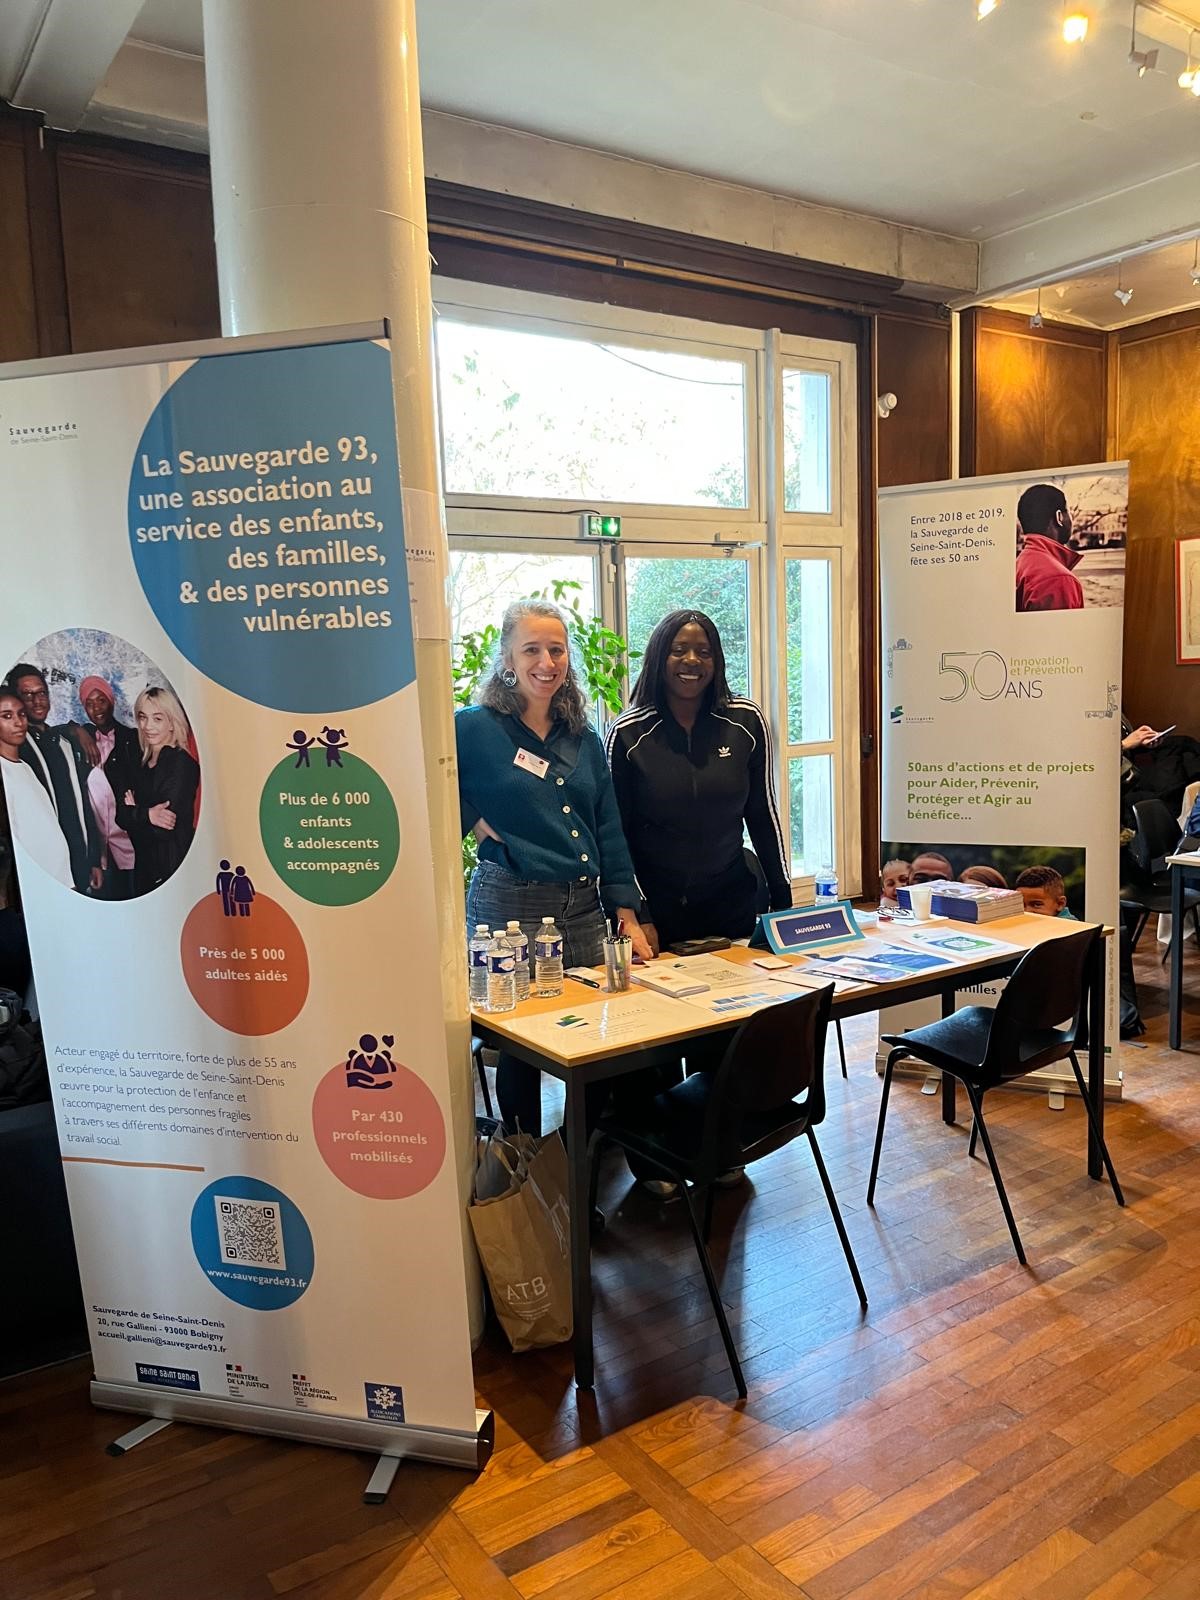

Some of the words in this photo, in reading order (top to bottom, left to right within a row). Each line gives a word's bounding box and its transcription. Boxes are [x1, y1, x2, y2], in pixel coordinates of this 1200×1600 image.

[9, 422, 77, 435] Sauvegarde
[142, 454, 173, 477] La
[178, 440, 330, 475] Sauvegarde
[337, 435, 378, 464] 93,
[139, 492, 184, 510] une
[191, 476, 332, 507] association
[340, 477, 372, 496] au
[136, 517, 222, 543] service
[229, 514, 271, 537] des
[279, 508, 384, 534] enfants,
[911, 516, 936, 525] Entre
[939, 512, 962, 522] 2018
[965, 512, 975, 520] et
[911, 530, 918, 538] la
[921, 525, 974, 537] Sauvegarde
[977, 524, 989, 532] de
[228, 547, 269, 569] des
[276, 540, 386, 566] familles,
[910, 556, 928, 566] fête
[930, 556, 945, 564] ses
[948, 554, 960, 562] 50
[963, 554, 979, 562] ans
[180, 582, 199, 604] &
[207, 580, 248, 602] des
[255, 577, 390, 606] personnes
[244, 605, 392, 632] vulnérables
[1010, 656, 1069, 666] Innovation
[939, 650, 1008, 702] 50
[1010, 667, 1020, 676] et
[1024, 665, 1083, 675] Prévention
[1005, 680, 1043, 699] ANS
[907, 762, 943, 772] 50ans
[947, 762, 1005, 772] d'actions
[1008, 762, 1022, 772] et
[1026, 762, 1043, 772] de
[1047, 762, 1095, 774] projets
[907, 780, 937, 790] pour
[940, 777, 978, 790] Aider,
[981, 778, 1039, 790] Prévenir,
[279, 792, 307, 806] Plus
[310, 793, 328, 806] de
[332, 792, 340, 805] 6
[345, 792, 370, 805] 000
[907, 793, 964, 806] Protéger
[967, 794, 981, 804] et
[983, 794, 1012, 807] Agir
[1016, 796, 1032, 805] au
[300, 816, 352, 827] enfants
[907, 809, 972, 820] bénéfice...
[283, 836, 294, 848] &
[297, 837, 379, 849] adolescents
[287, 859, 380, 874] accompagnés
[795, 924, 825, 934] SAUVEGARDE
[200, 947, 227, 959] Près
[231, 948, 246, 959] de
[250, 948, 257, 959] 5
[262, 948, 285, 960] 000
[205, 968, 250, 980] adultes
[254, 970, 288, 981] aidés
[55, 1046, 86, 1056] Acteur
[89, 1050, 120, 1061] engagé
[122, 1050, 134, 1060] du
[137, 1052, 184, 1062] territoire,
[186, 1052, 210, 1063] forte
[212, 1055, 224, 1064] de
[227, 1056, 246, 1068] plus
[249, 1057, 261, 1067] de
[264, 1057, 277, 1067] 55
[280, 1060, 297, 1068] ans
[57, 1064, 117, 1077] d'expérience,
[120, 1068, 127, 1077] la
[129, 1067, 183, 1080] Sauvegarde
[187, 1070, 198, 1080] de
[201, 1071, 285, 1086] Seine-Saint-Denis
[60, 1082, 90, 1091] œuvre
[93, 1084, 113, 1094] pour
[116, 1084, 124, 1094] la
[126, 1086, 176, 1096] protection
[179, 1088, 190, 1097] de
[194, 1088, 234, 1101] l'enfance
[237, 1094, 247, 1103] et
[62, 1098, 146, 1113] l'accompagnement
[149, 1104, 166, 1113] des
[168, 1106, 216, 1118] personnes
[218, 1108, 251, 1122] fragiles
[352, 1109, 375, 1122] Par
[380, 1111, 403, 1123] 430
[64, 1115, 70, 1125] à
[72, 1117, 104, 1128] travers
[106, 1121, 120, 1129] ses
[122, 1120, 168, 1132] différents
[170, 1123, 214, 1135] domaines
[217, 1127, 283, 1141] d'intervention
[286, 1132, 299, 1142] du
[67, 1133, 94, 1143] travail
[332, 1130, 428, 1145] professionnels
[350, 1151, 414, 1164] mobilisés
[207, 1269, 307, 1288] www.sauvegarde93.fr
[506, 1276, 546, 1300] ATB
[92, 1305, 139, 1318] Sauvegarde
[140, 1311, 150, 1319] de
[153, 1313, 225, 1328] Seine-Saint-Denis
[111, 1320, 125, 1328] rue
[126, 1322, 157, 1332] Gallieni
[164, 1327, 188, 1336] 93000
[190, 1330, 224, 1342] Bobigny
[98, 1330, 226, 1353] accueil.gallieni@sauvegarde93.fr
[246, 1381, 269, 1389] JUSTICE
